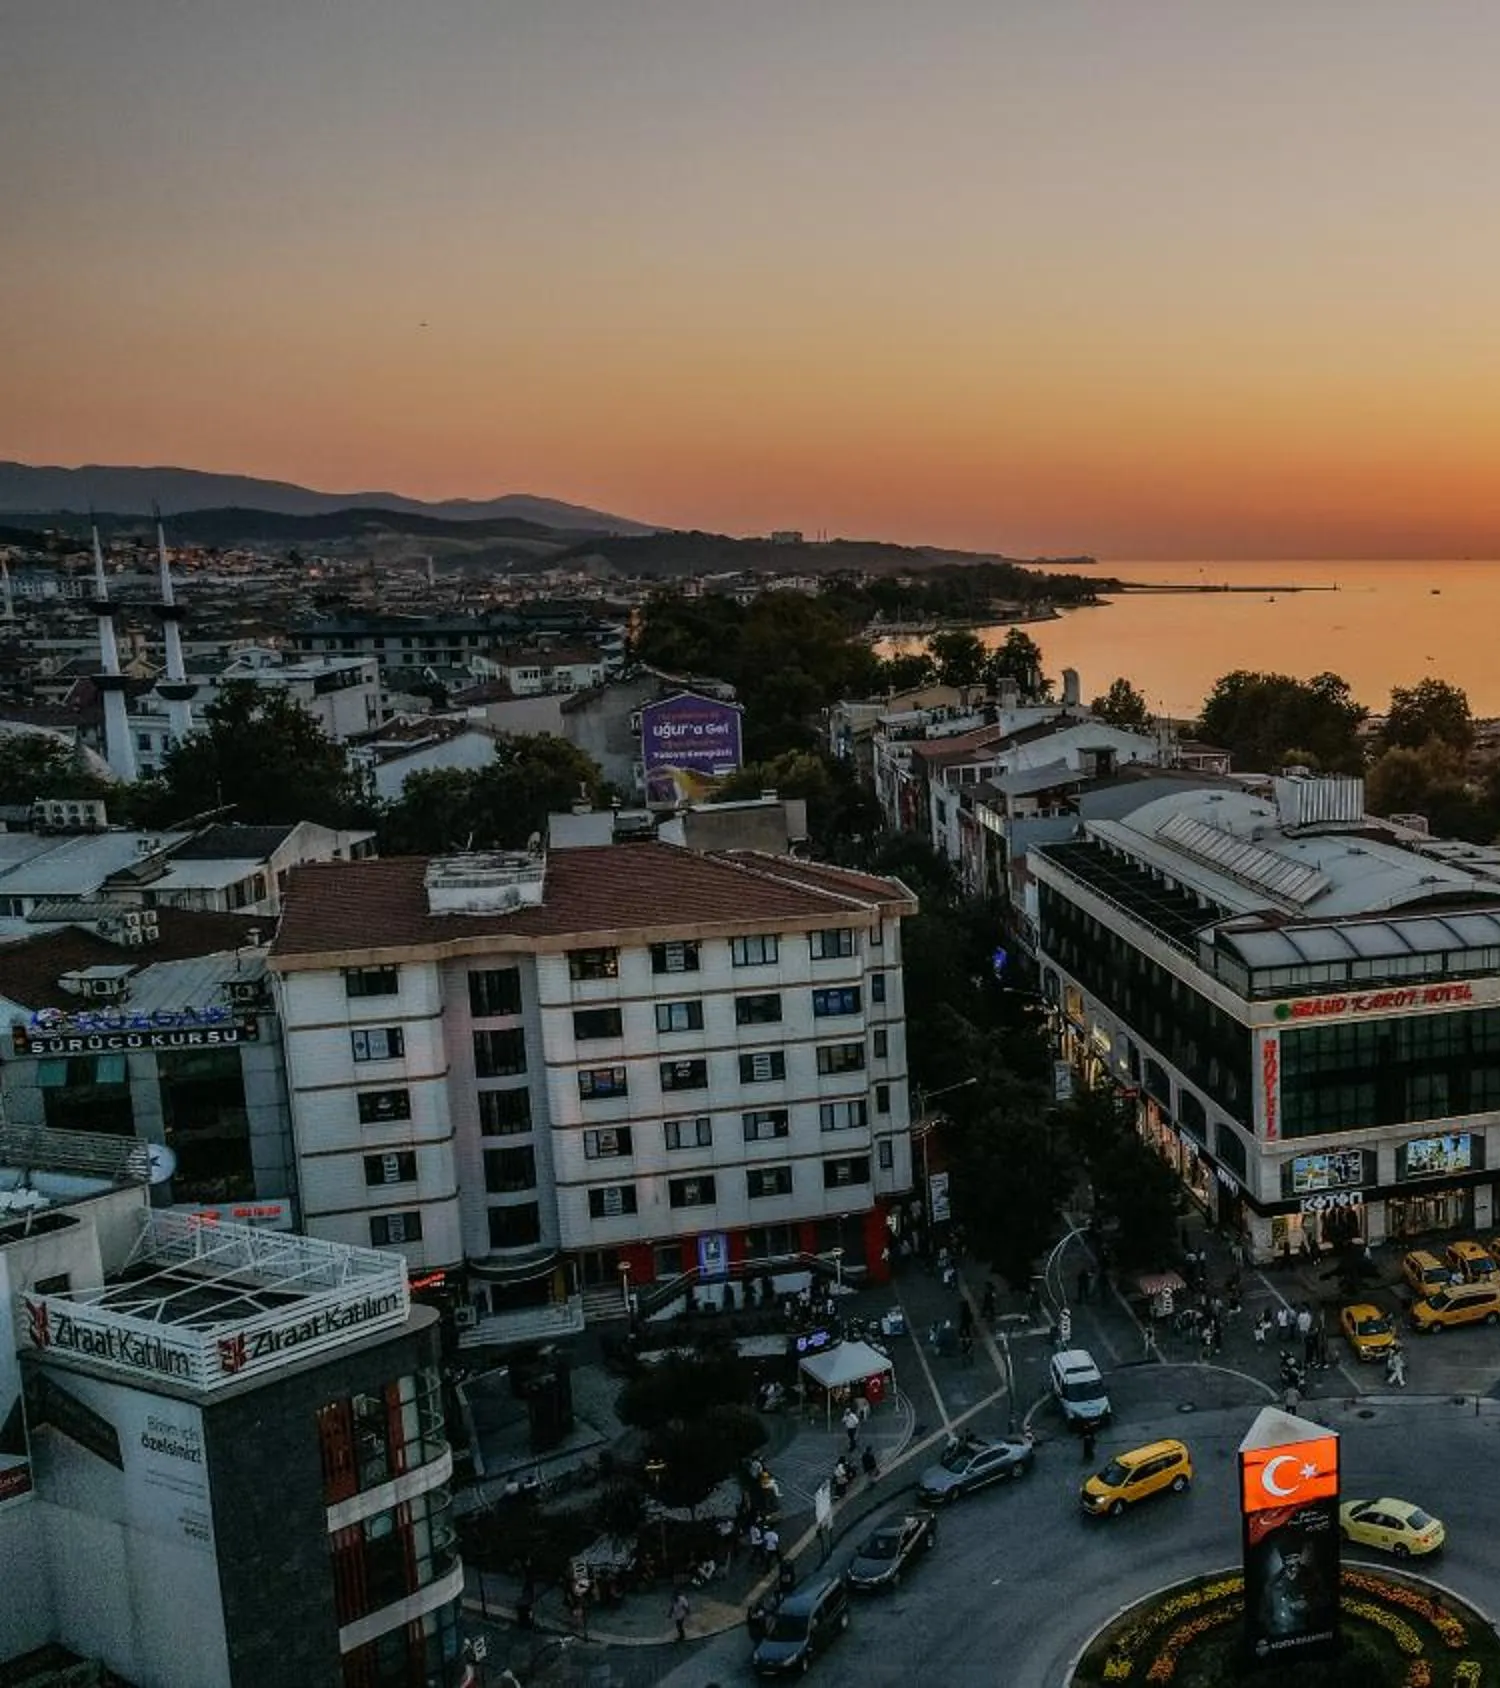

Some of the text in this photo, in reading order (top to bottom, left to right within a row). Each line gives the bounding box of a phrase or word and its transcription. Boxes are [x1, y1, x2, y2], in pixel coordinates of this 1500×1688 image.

[31, 1029, 238, 1053] SÜRÜCÜ KURSU
[53, 1311, 115, 1358] Ziraat
[253, 1315, 324, 1358] Ziraat
